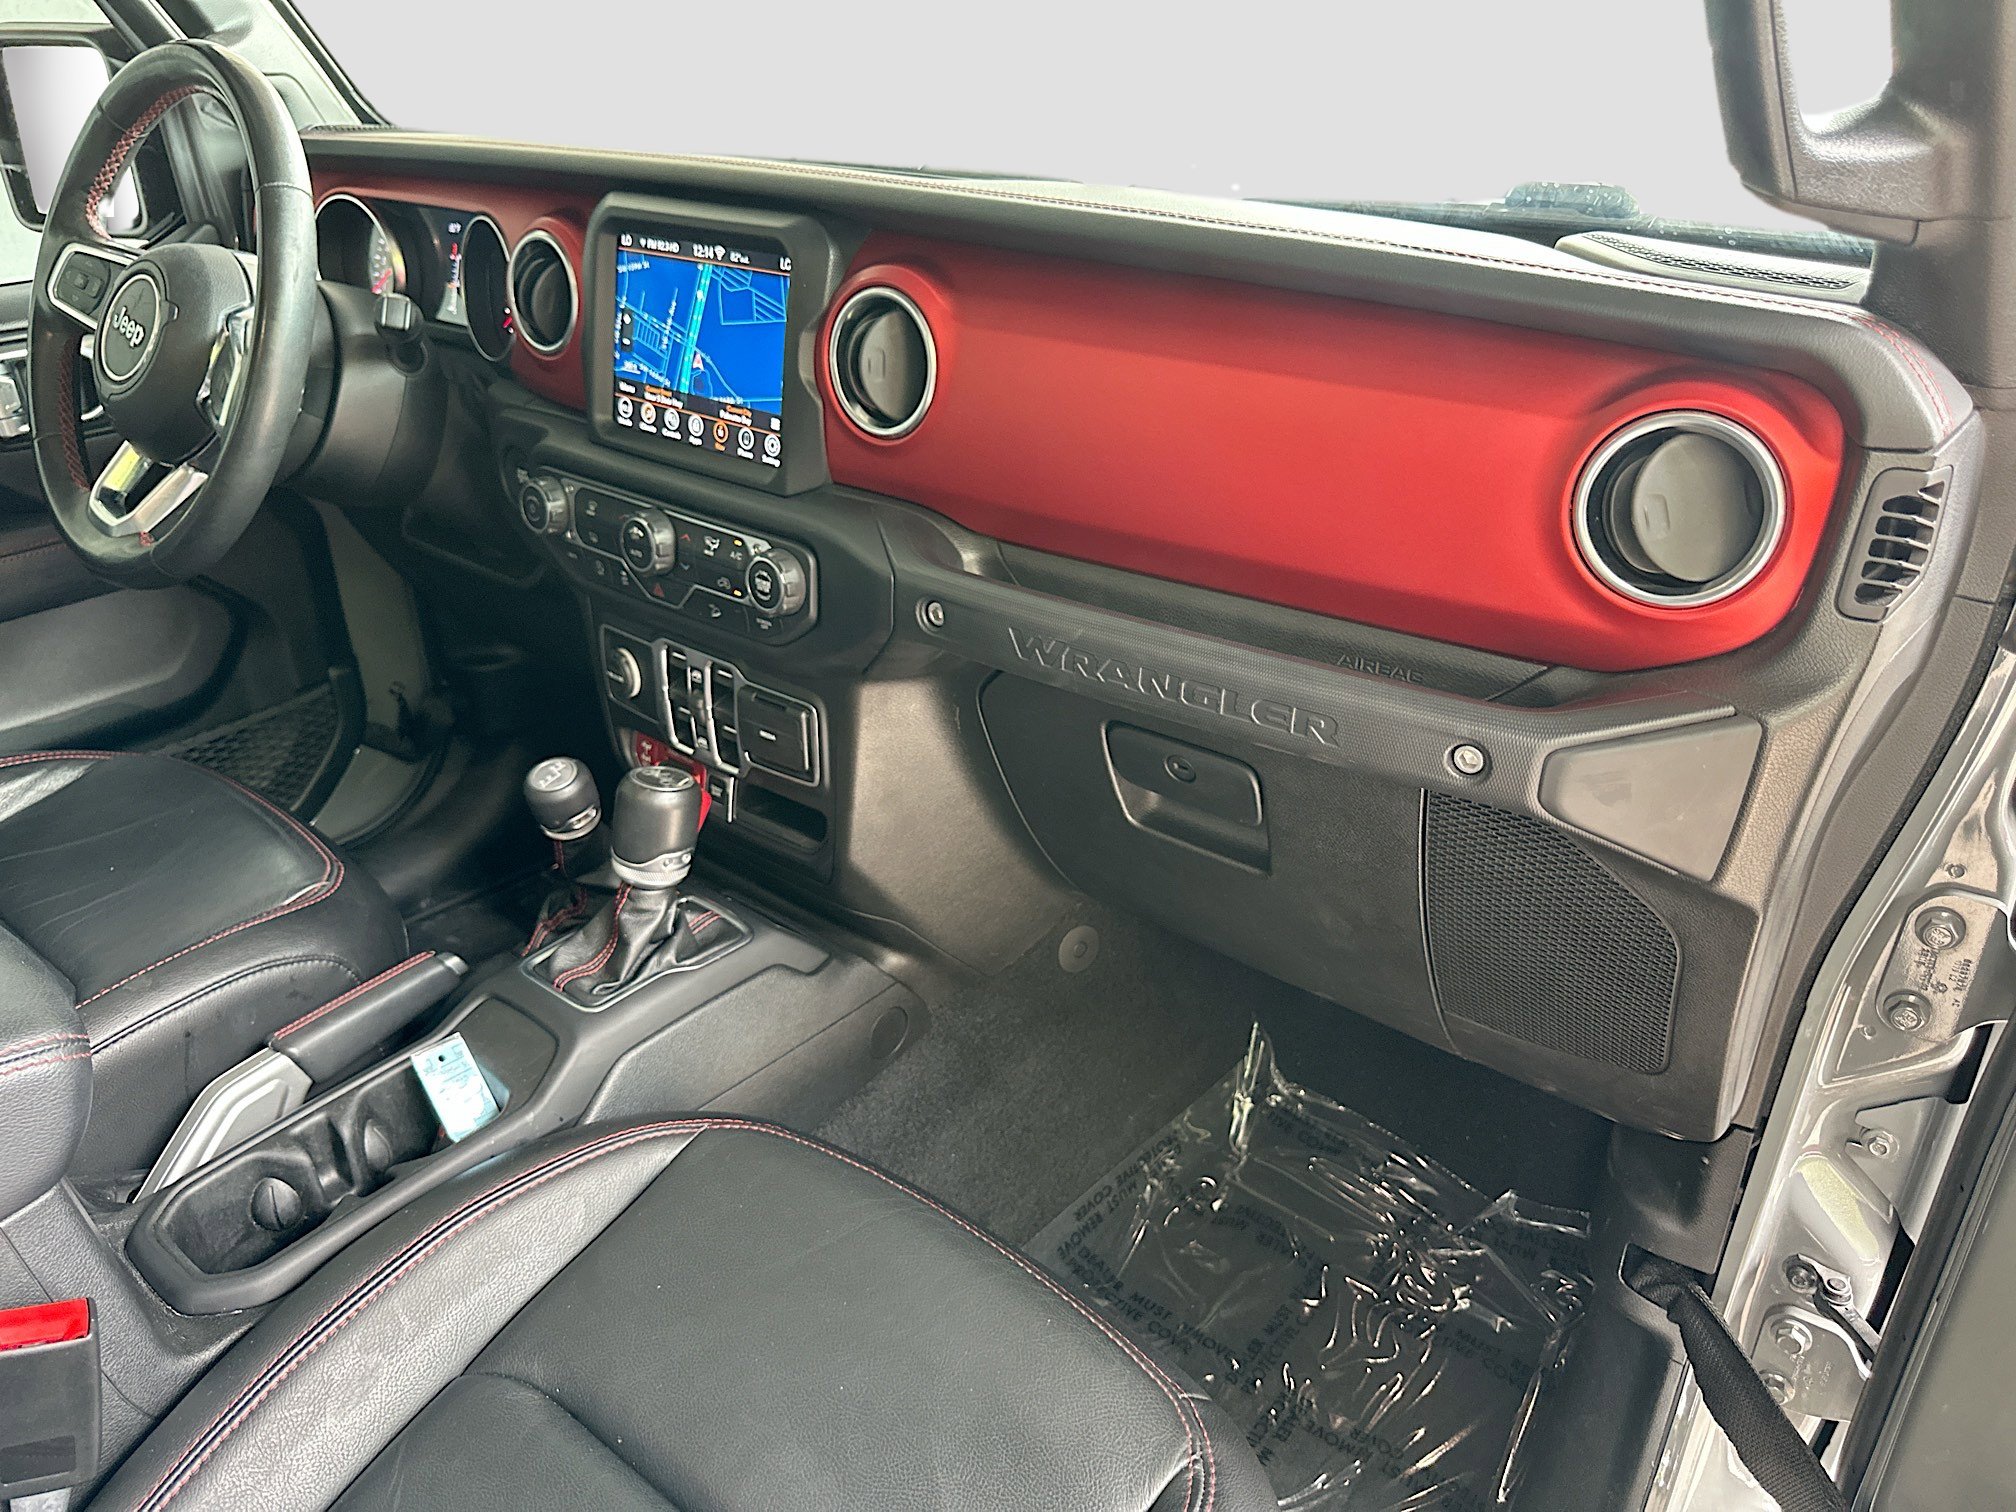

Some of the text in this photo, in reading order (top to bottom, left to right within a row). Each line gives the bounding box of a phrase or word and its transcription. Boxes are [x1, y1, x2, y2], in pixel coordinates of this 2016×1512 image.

[113, 306, 145, 347] Jeep
[1008, 626, 1341, 747] WRANGLER
[1337, 654, 1424, 684] AIRBAG
[1072, 1182, 1114, 1223] COVER
[1103, 1179, 1139, 1214] MUST
[1056, 1208, 1105, 1261] REMOVE
[1129, 1289, 1172, 1322] MUST
